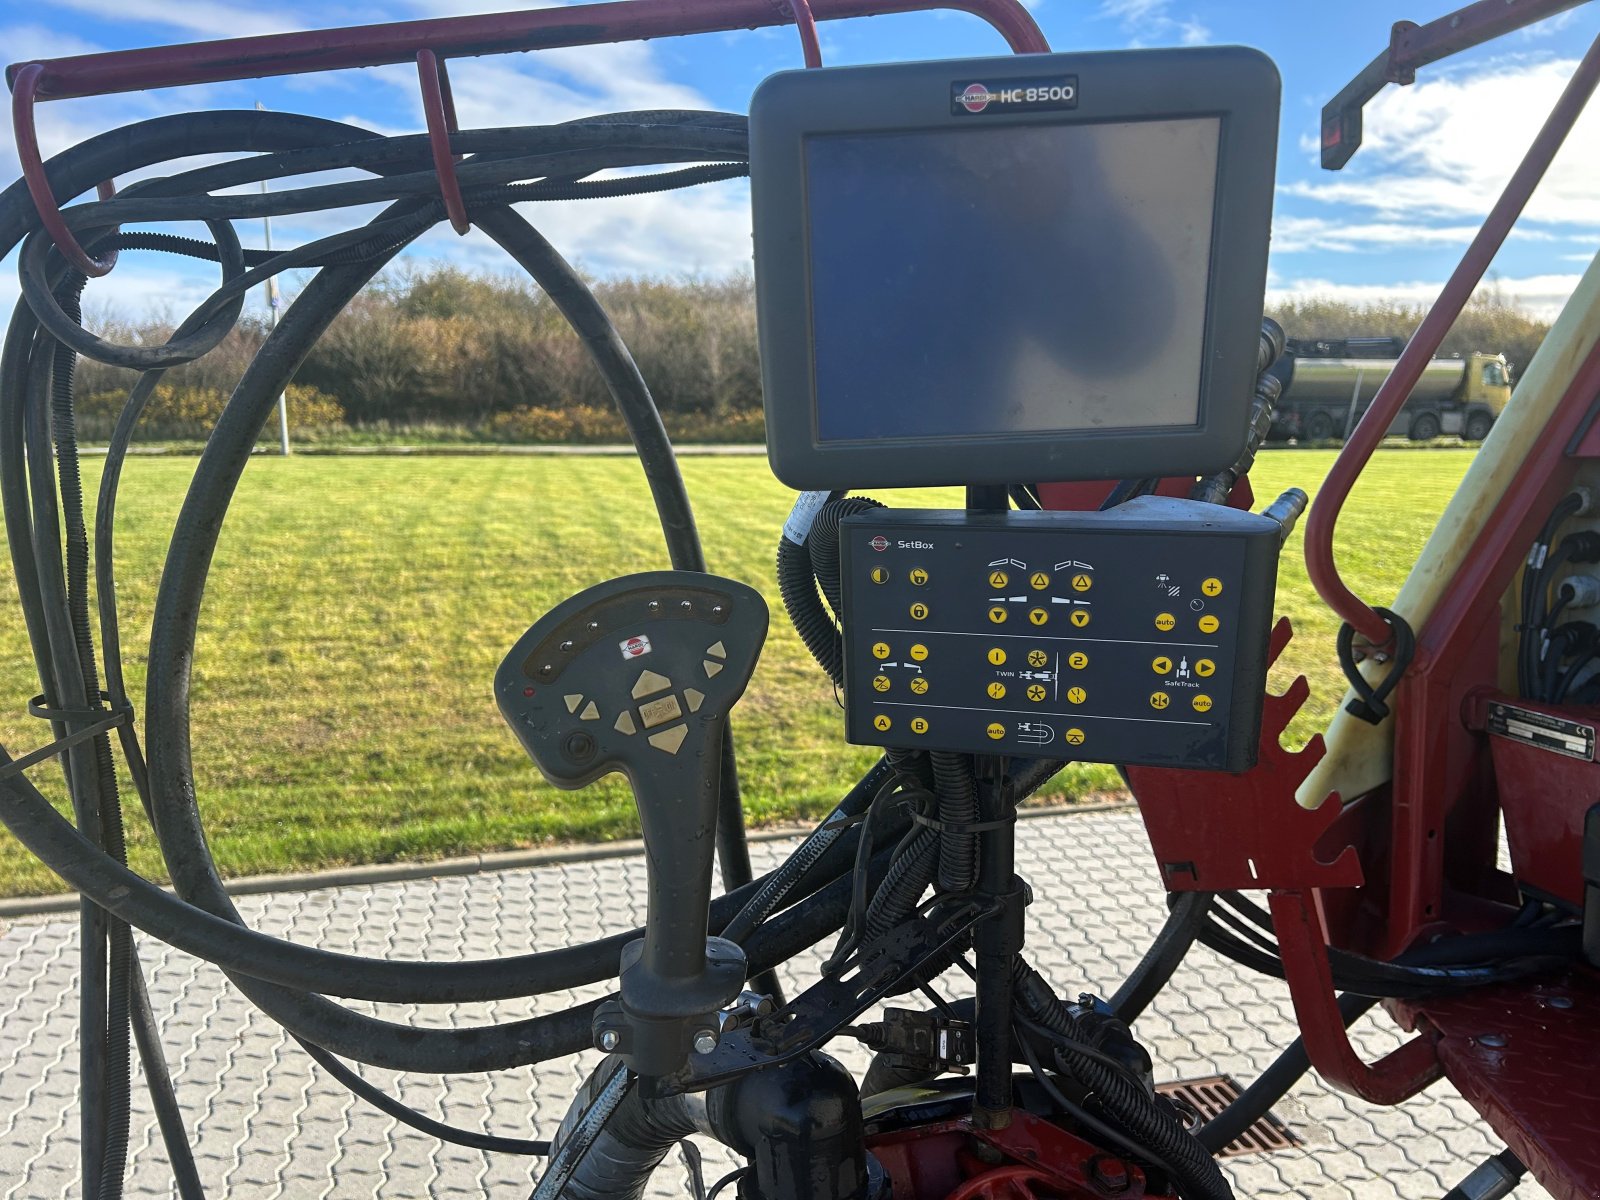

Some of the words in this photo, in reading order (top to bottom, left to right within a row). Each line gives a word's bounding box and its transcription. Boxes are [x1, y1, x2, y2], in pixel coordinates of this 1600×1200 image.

[1001, 89, 1022, 103] HC
[1026, 86, 1074, 102] 8500
[897, 540, 934, 550] SetBox
[1073, 656, 1083, 666] 2
[878, 719, 886, 727] A
[915, 721, 924, 730] B
